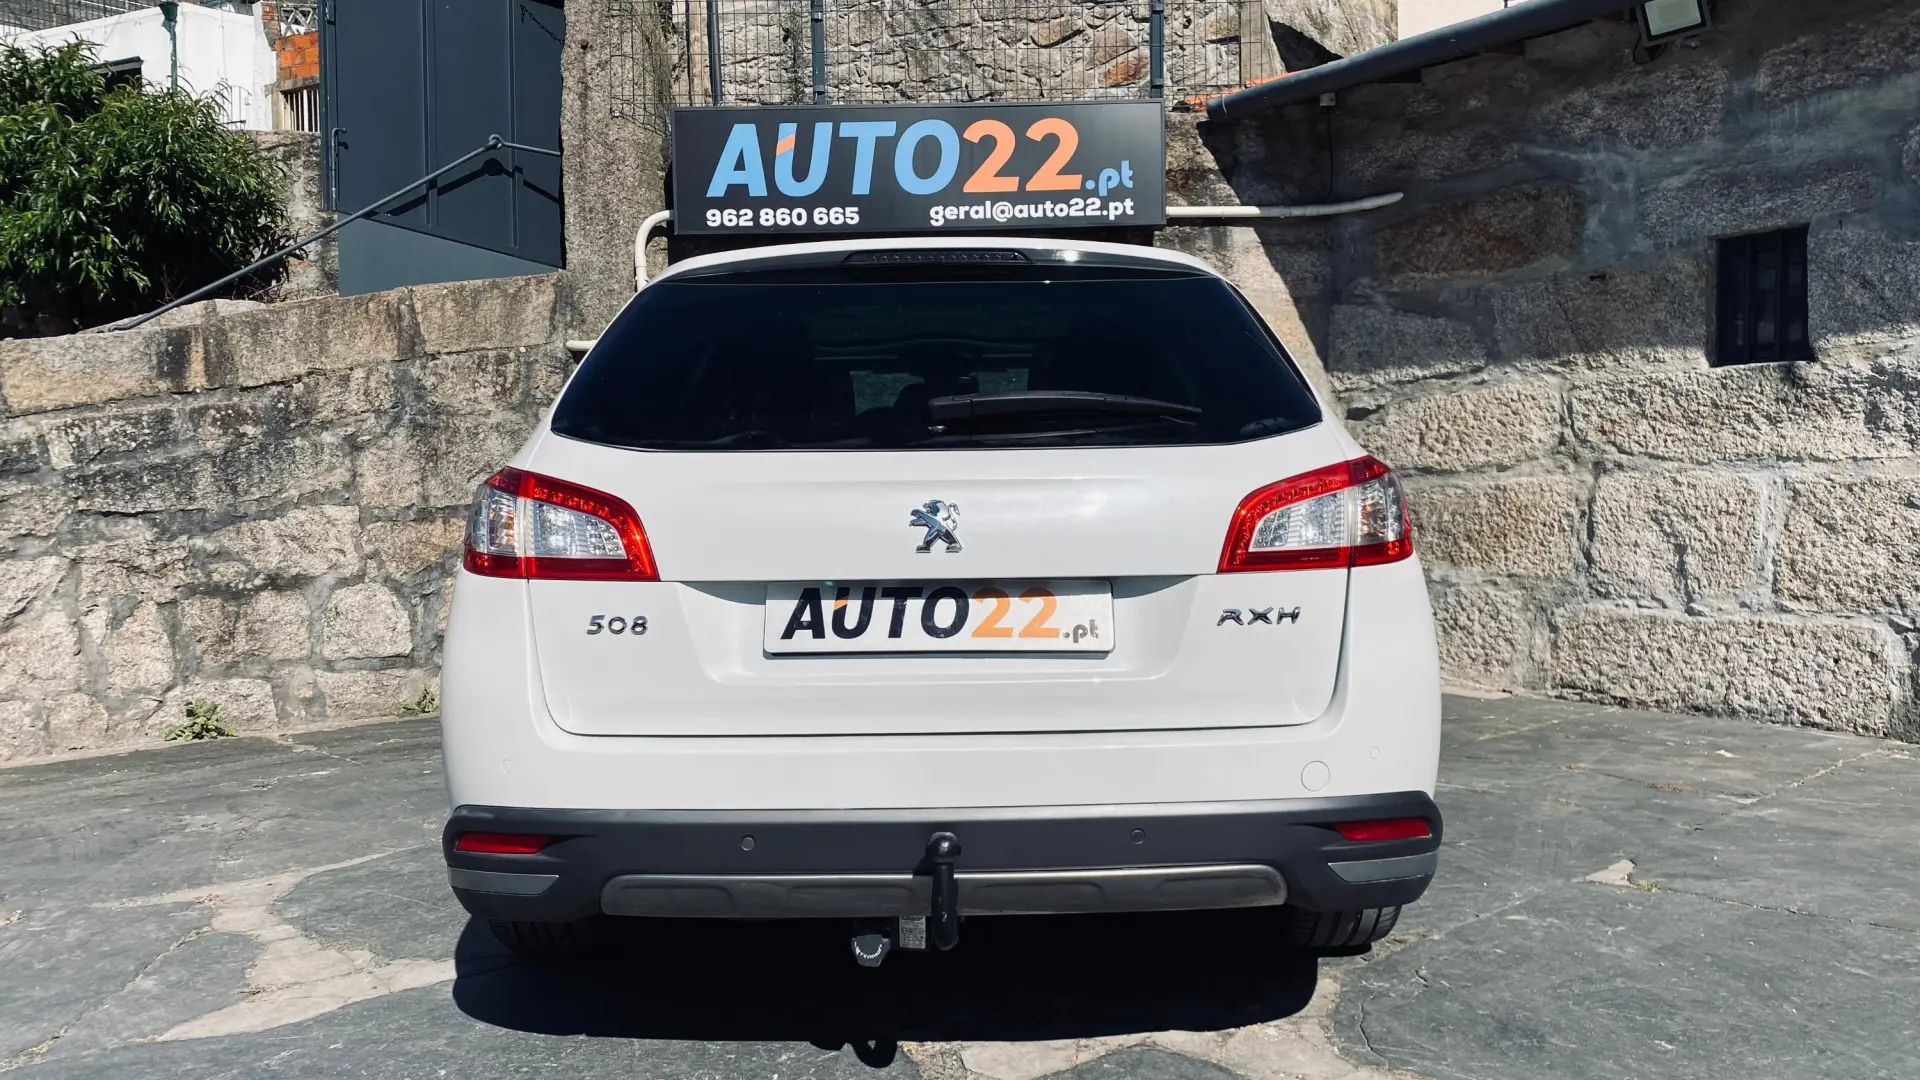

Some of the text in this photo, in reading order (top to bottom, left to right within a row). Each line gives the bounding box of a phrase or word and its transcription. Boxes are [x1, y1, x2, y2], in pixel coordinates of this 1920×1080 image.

[706, 117, 1134, 197] AUTO22.pt
[706, 206, 860, 227] 962 860 665
[929, 197, 1135, 227] geral@auto22.pt
[586, 614, 648, 636] 508
[780, 586, 1099, 643] AUTO22.pt
[1216, 606, 1301, 627] RXH
